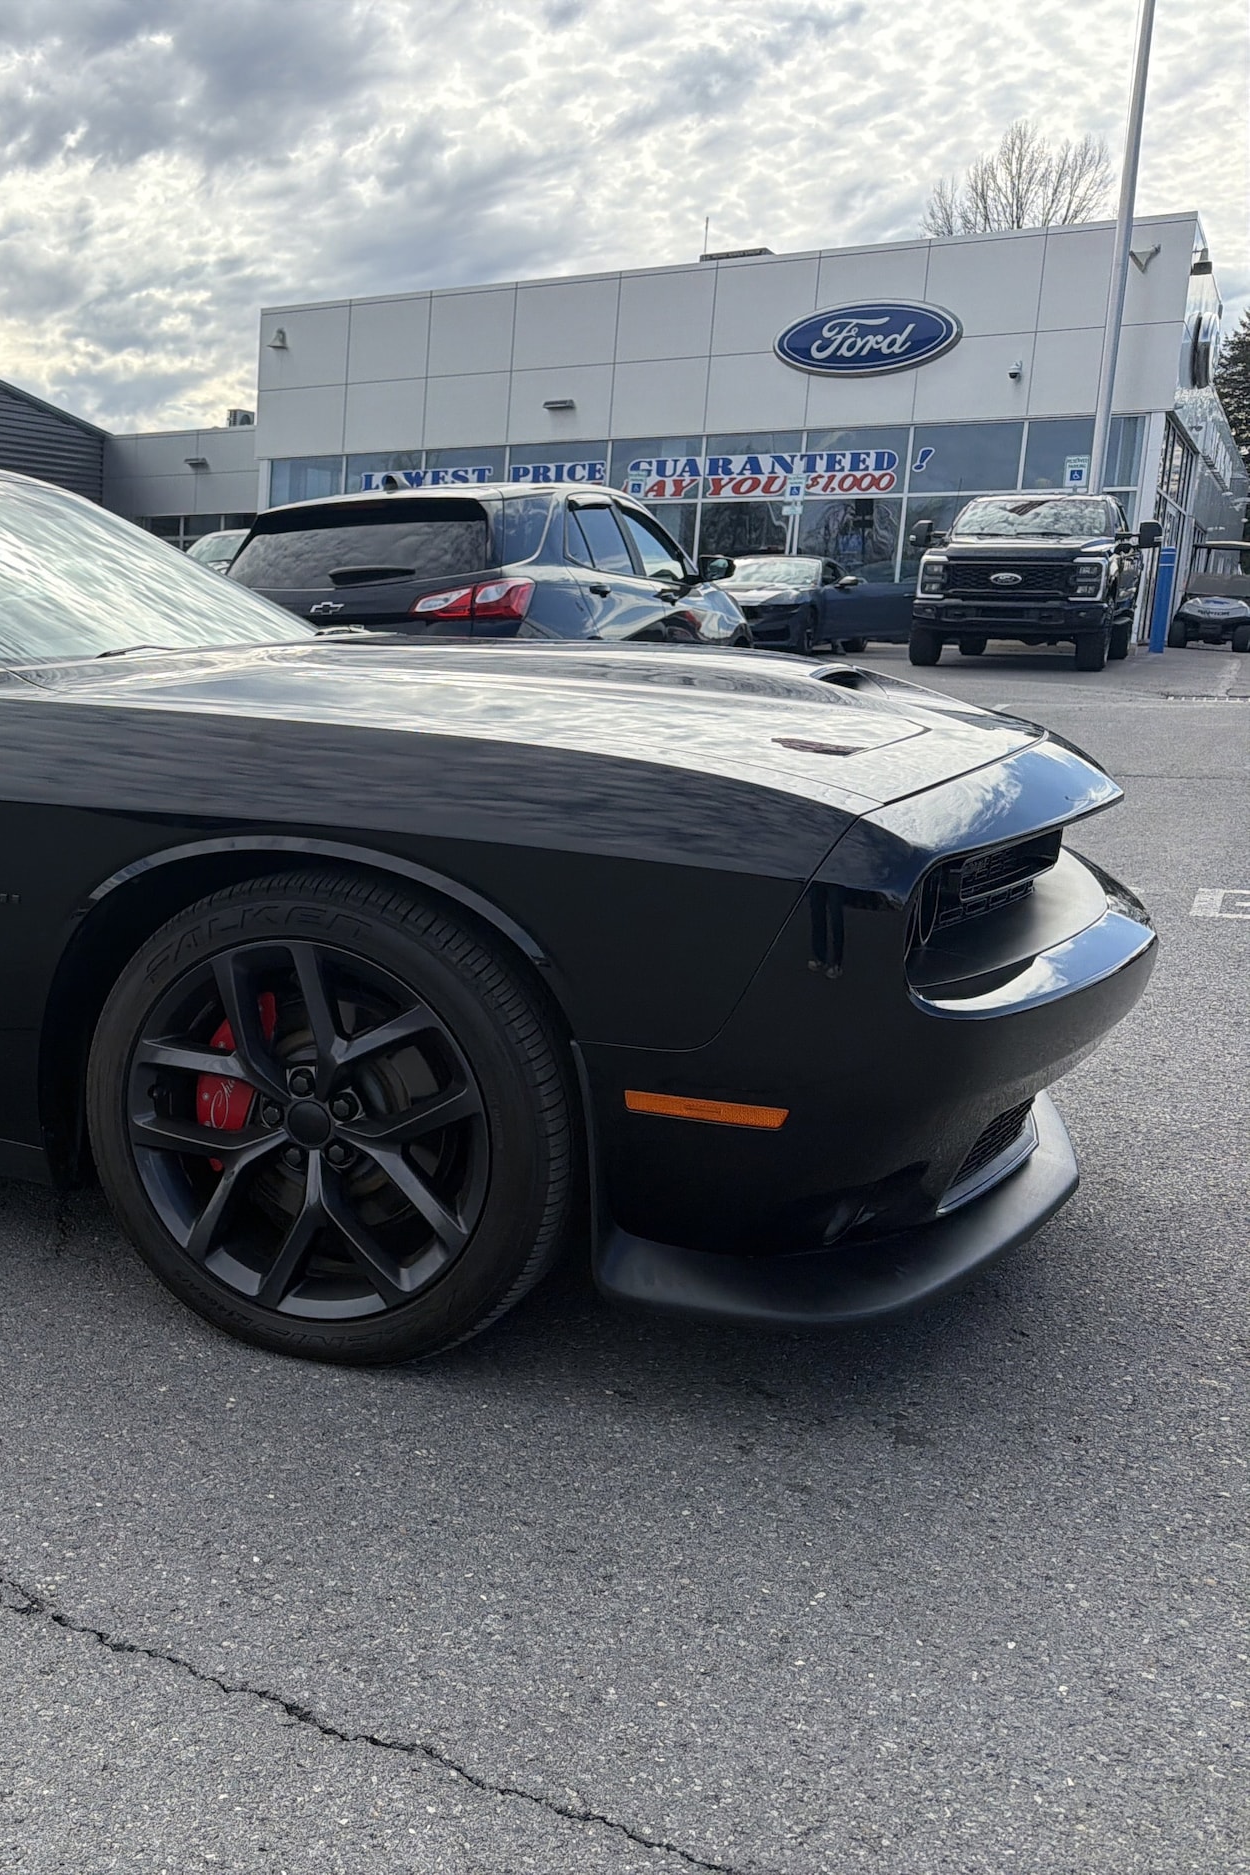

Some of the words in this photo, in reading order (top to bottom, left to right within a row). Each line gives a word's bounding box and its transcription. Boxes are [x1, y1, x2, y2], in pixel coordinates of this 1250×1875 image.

[810, 316, 916, 360] Ford
[511, 461, 606, 484] PRICE
[629, 451, 898, 478] GUARANTEED
[622, 478, 698, 497] AY
[708, 476, 788, 496] YOU
[806, 472, 895, 492] $1,000
